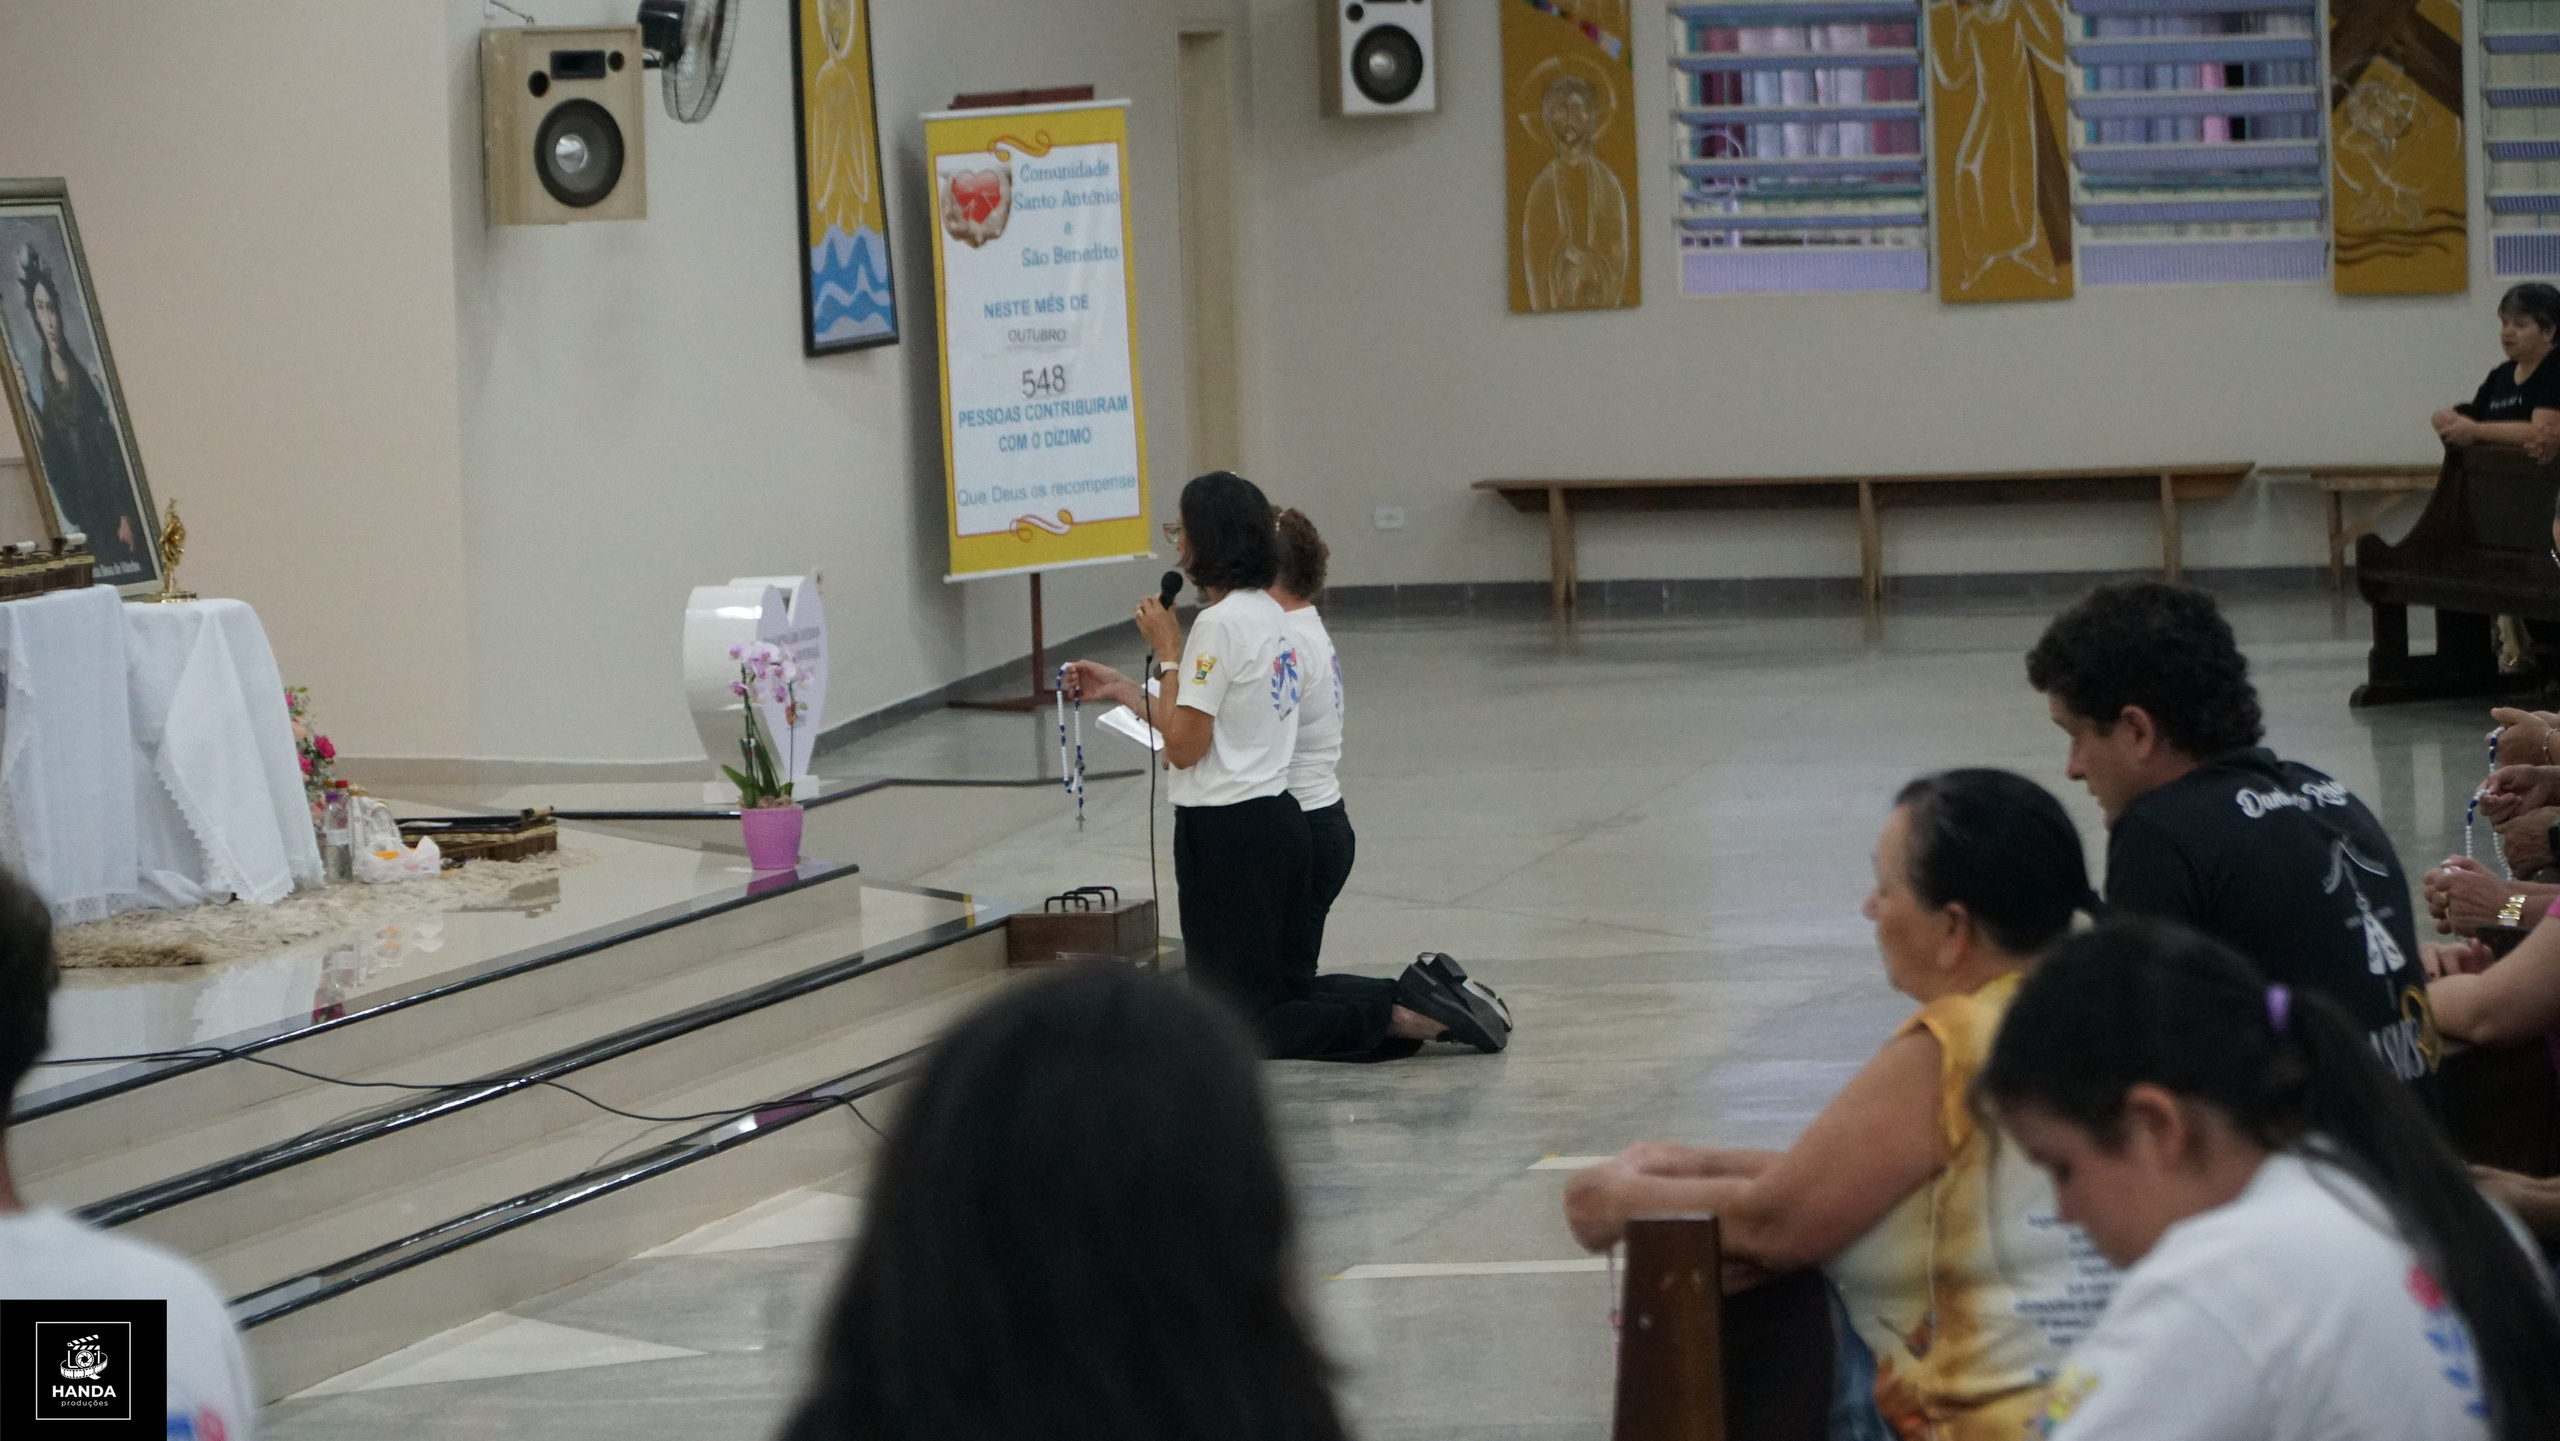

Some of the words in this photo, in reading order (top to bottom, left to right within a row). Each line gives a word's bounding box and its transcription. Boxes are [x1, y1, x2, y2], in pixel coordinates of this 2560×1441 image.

[1020, 161, 1110, 183] Comunidade
[1013, 192, 1056, 212] Santo
[1064, 222, 1072, 234] e
[1021, 247, 1049, 267] São
[1053, 244, 1118, 266] Benedito
[984, 300, 1031, 319] NESTE
[1034, 293, 1064, 314] MÊS
[1070, 294, 1089, 311] DE
[1008, 328, 1066, 343] OUTUBRO
[1022, 364, 1066, 398] 548
[958, 405, 1021, 428] PESSOAS
[1025, 395, 1128, 422] CONTRIBUIRAM
[998, 433, 1028, 452] COM
[1032, 434, 1040, 450] O
[1044, 424, 1091, 448] DÍZIMO
[957, 489, 987, 507] Que
[992, 486, 1026, 504] Deus
[1030, 486, 1047, 499] os
[1051, 475, 1135, 496] recompense
